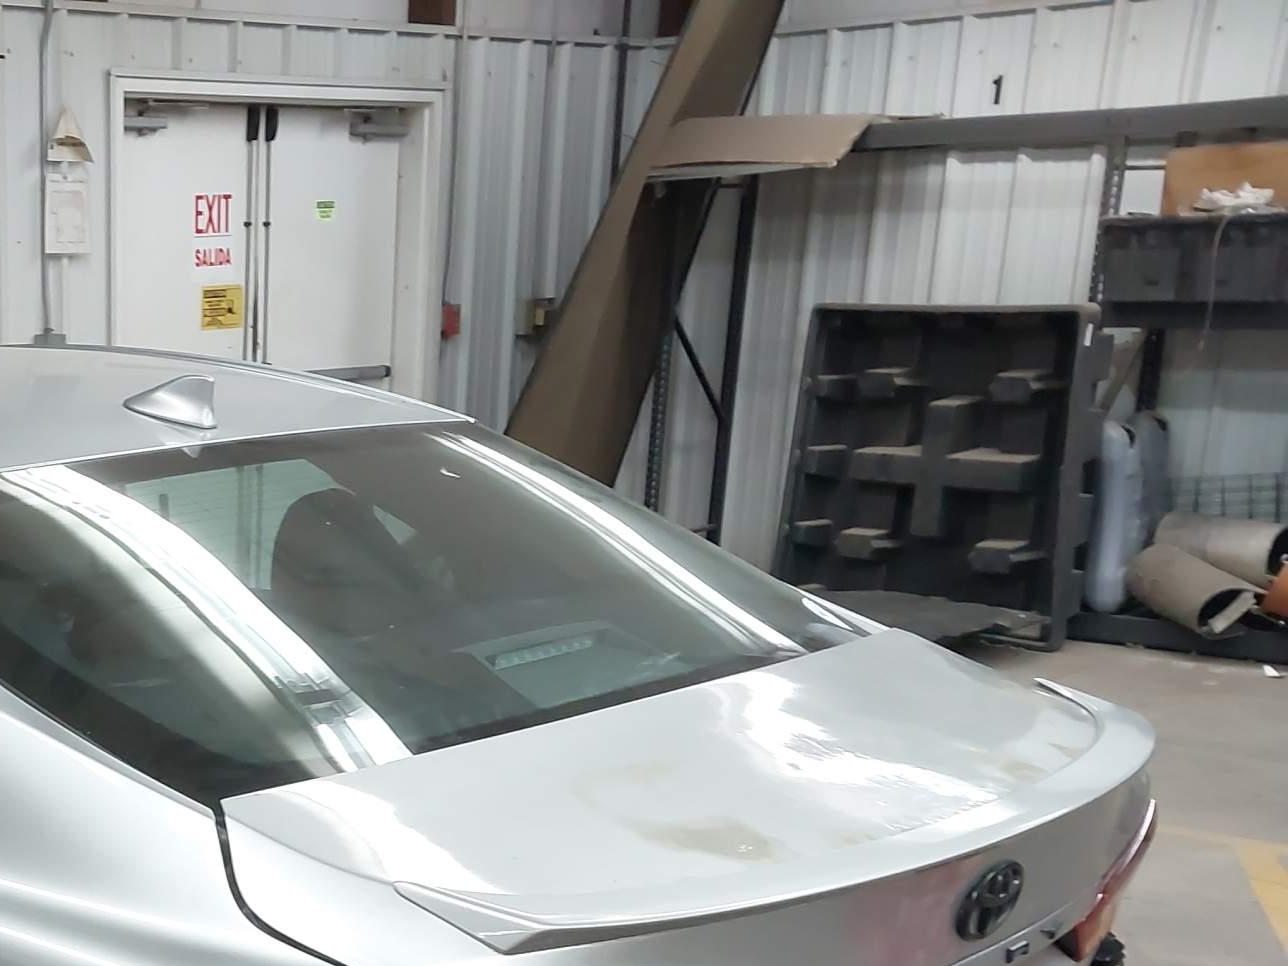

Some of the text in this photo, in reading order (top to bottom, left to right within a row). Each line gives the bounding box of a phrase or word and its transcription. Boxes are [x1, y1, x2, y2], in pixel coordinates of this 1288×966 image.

[992, 75, 1003, 105] 1
[195, 194, 232, 234] EXIT
[195, 248, 231, 267] SALIDA
